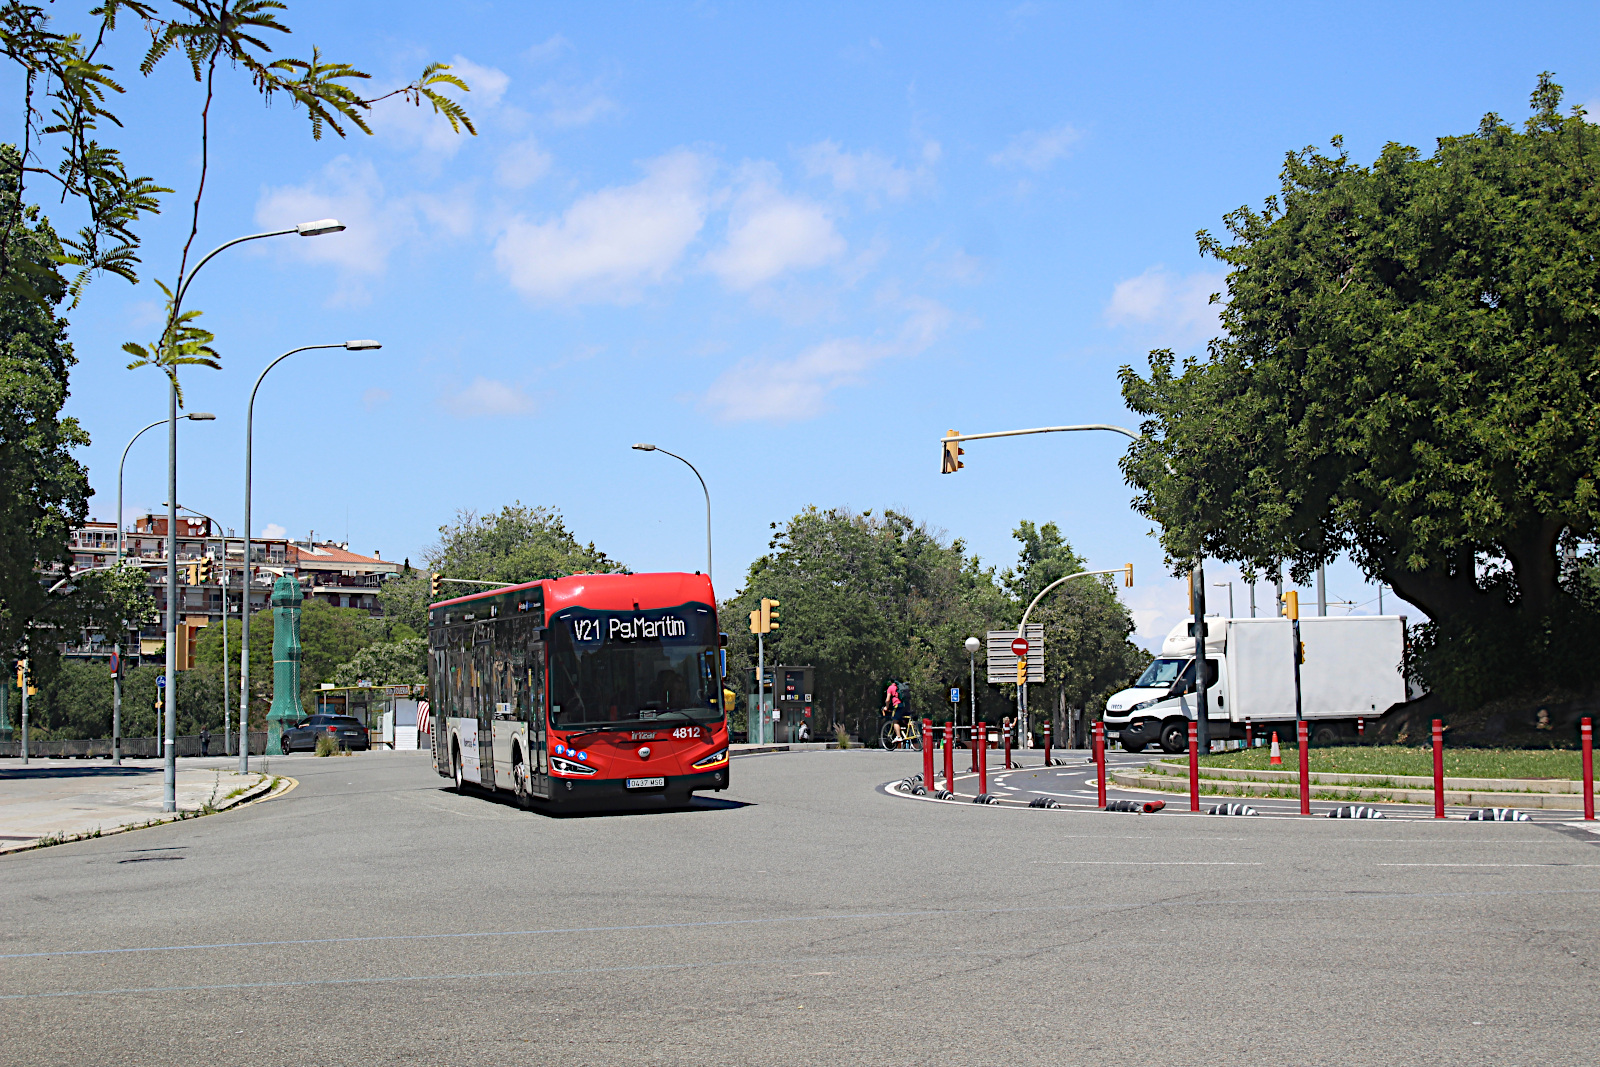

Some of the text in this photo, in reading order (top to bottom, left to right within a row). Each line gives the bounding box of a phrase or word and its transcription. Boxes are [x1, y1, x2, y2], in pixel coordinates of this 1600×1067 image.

[574, 615, 686, 640] V21 Pg.Marítim
[631, 730, 657, 740] irizar
[672, 727, 700, 738] 4812
